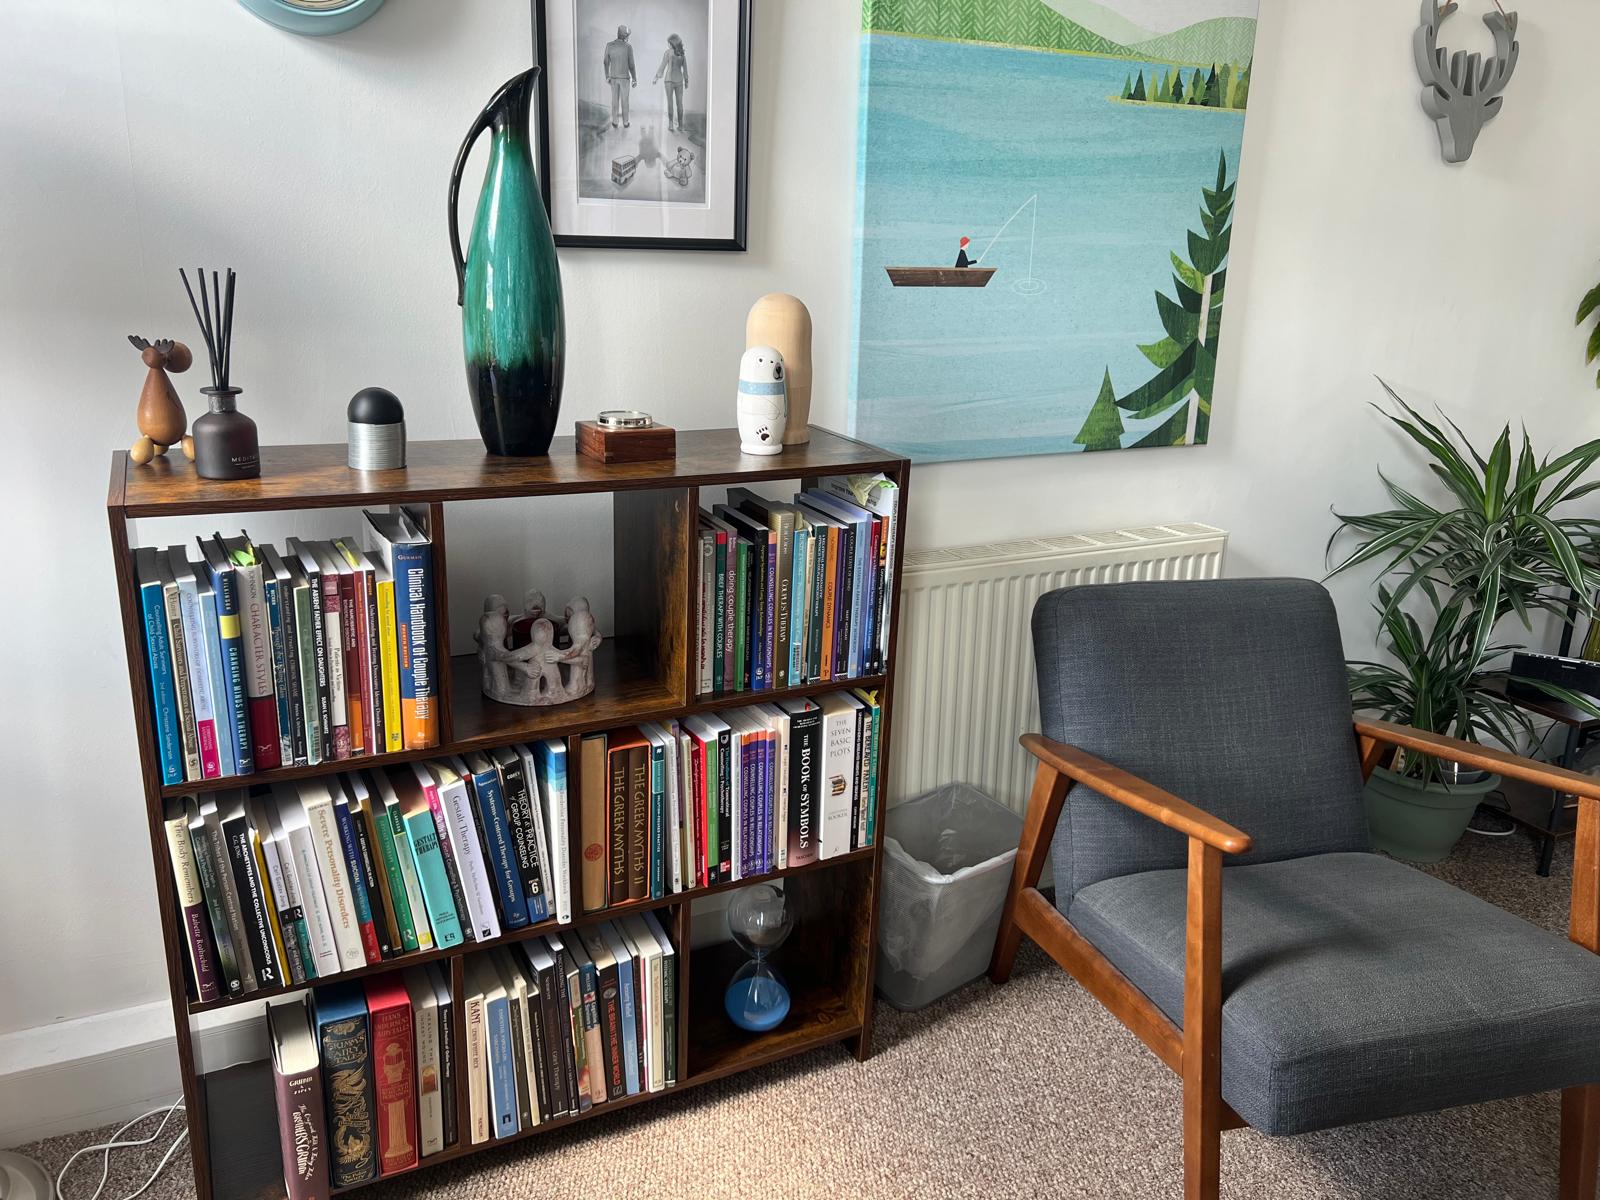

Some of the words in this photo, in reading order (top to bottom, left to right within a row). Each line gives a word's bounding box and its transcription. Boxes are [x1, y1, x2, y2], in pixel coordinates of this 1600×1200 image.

[248, 571, 257, 598] JOHNSON
[408, 568, 425, 601] Clinical
[148, 619, 156, 633] Child
[249, 603, 264, 662] CHARACTER
[410, 604, 427, 644] Handbook
[150, 635, 158, 650] Sexual
[154, 605, 163, 634] Counselling
[159, 650, 167, 674] Survivors
[175, 639, 184, 664] Survivors
[317, 648, 323, 657] ON
[152, 652, 160, 669] Abuse
[229, 648, 240, 683] CHANGING
[413, 658, 429, 686] Couple
[256, 664, 268, 695] STYLES
[233, 686, 243, 708] MINDS
[414, 688, 430, 720] Therapy
[237, 720, 248, 750] THERAPY
[830, 737, 851, 747] BASIC
[831, 728, 851, 737] SEVEN
[800, 748, 811, 784] BOOK
[830, 748, 850, 758] PLOTS
[615, 767, 624, 792] THE
[635, 764, 645, 789] THE
[803, 784, 808, 792] OF
[452, 796, 466, 822] Gestalt
[510, 803, 522, 826] GROUP
[615, 795, 624, 832] GREEK
[635, 792, 644, 827] GREEK
[798, 793, 811, 848] SYMBOLS
[175, 824, 185, 839] The
[318, 809, 331, 838] Severe
[517, 789, 530, 819] THEORY
[525, 829, 539, 868] PRACTICE
[177, 840, 189, 859] Body
[214, 842, 223, 857] Tribes
[235, 846, 243, 858] JUNG
[239, 834, 247, 844] THE
[458, 825, 474, 855] Therapy
[487, 790, 504, 844] Systems-Centered
[498, 845, 509, 870] Therapy
[506, 880, 516, 902] Groups
[515, 828, 529, 869] COUNSELING
[635, 830, 644, 871] MYTHS
[241, 845, 254, 876] ARCHETYPES
[323, 840, 343, 887] Personality
[615, 834, 625, 875] MYTHS
[182, 860, 197, 904] Remembers
[219, 864, 227, 873] the
[248, 876, 256, 886] AND
[634, 876, 644, 884] II
[222, 874, 236, 913] Person-Centred
[250, 887, 258, 897] THE
[532, 882, 538, 894] 6
[231, 914, 240, 930] Nation
[253, 899, 265, 929] COLLECTIVE
[336, 889, 352, 928] Disorders
[192, 914, 203, 939] Babette
[196, 940, 208, 972] Rothschild
[260, 930, 272, 964] UNCONSCIOUS
[557, 955, 565, 988] UNCOVERING
[471, 1001, 480, 1024] KANT
[609, 1014, 617, 1031] BRAIN
[610, 1034, 618, 1046] THE
[611, 1048, 620, 1065] INNER
[613, 1066, 621, 1085] WORLD
[292, 1112, 308, 1144] BROTHERS
[296, 1144, 310, 1175] GRIMM
